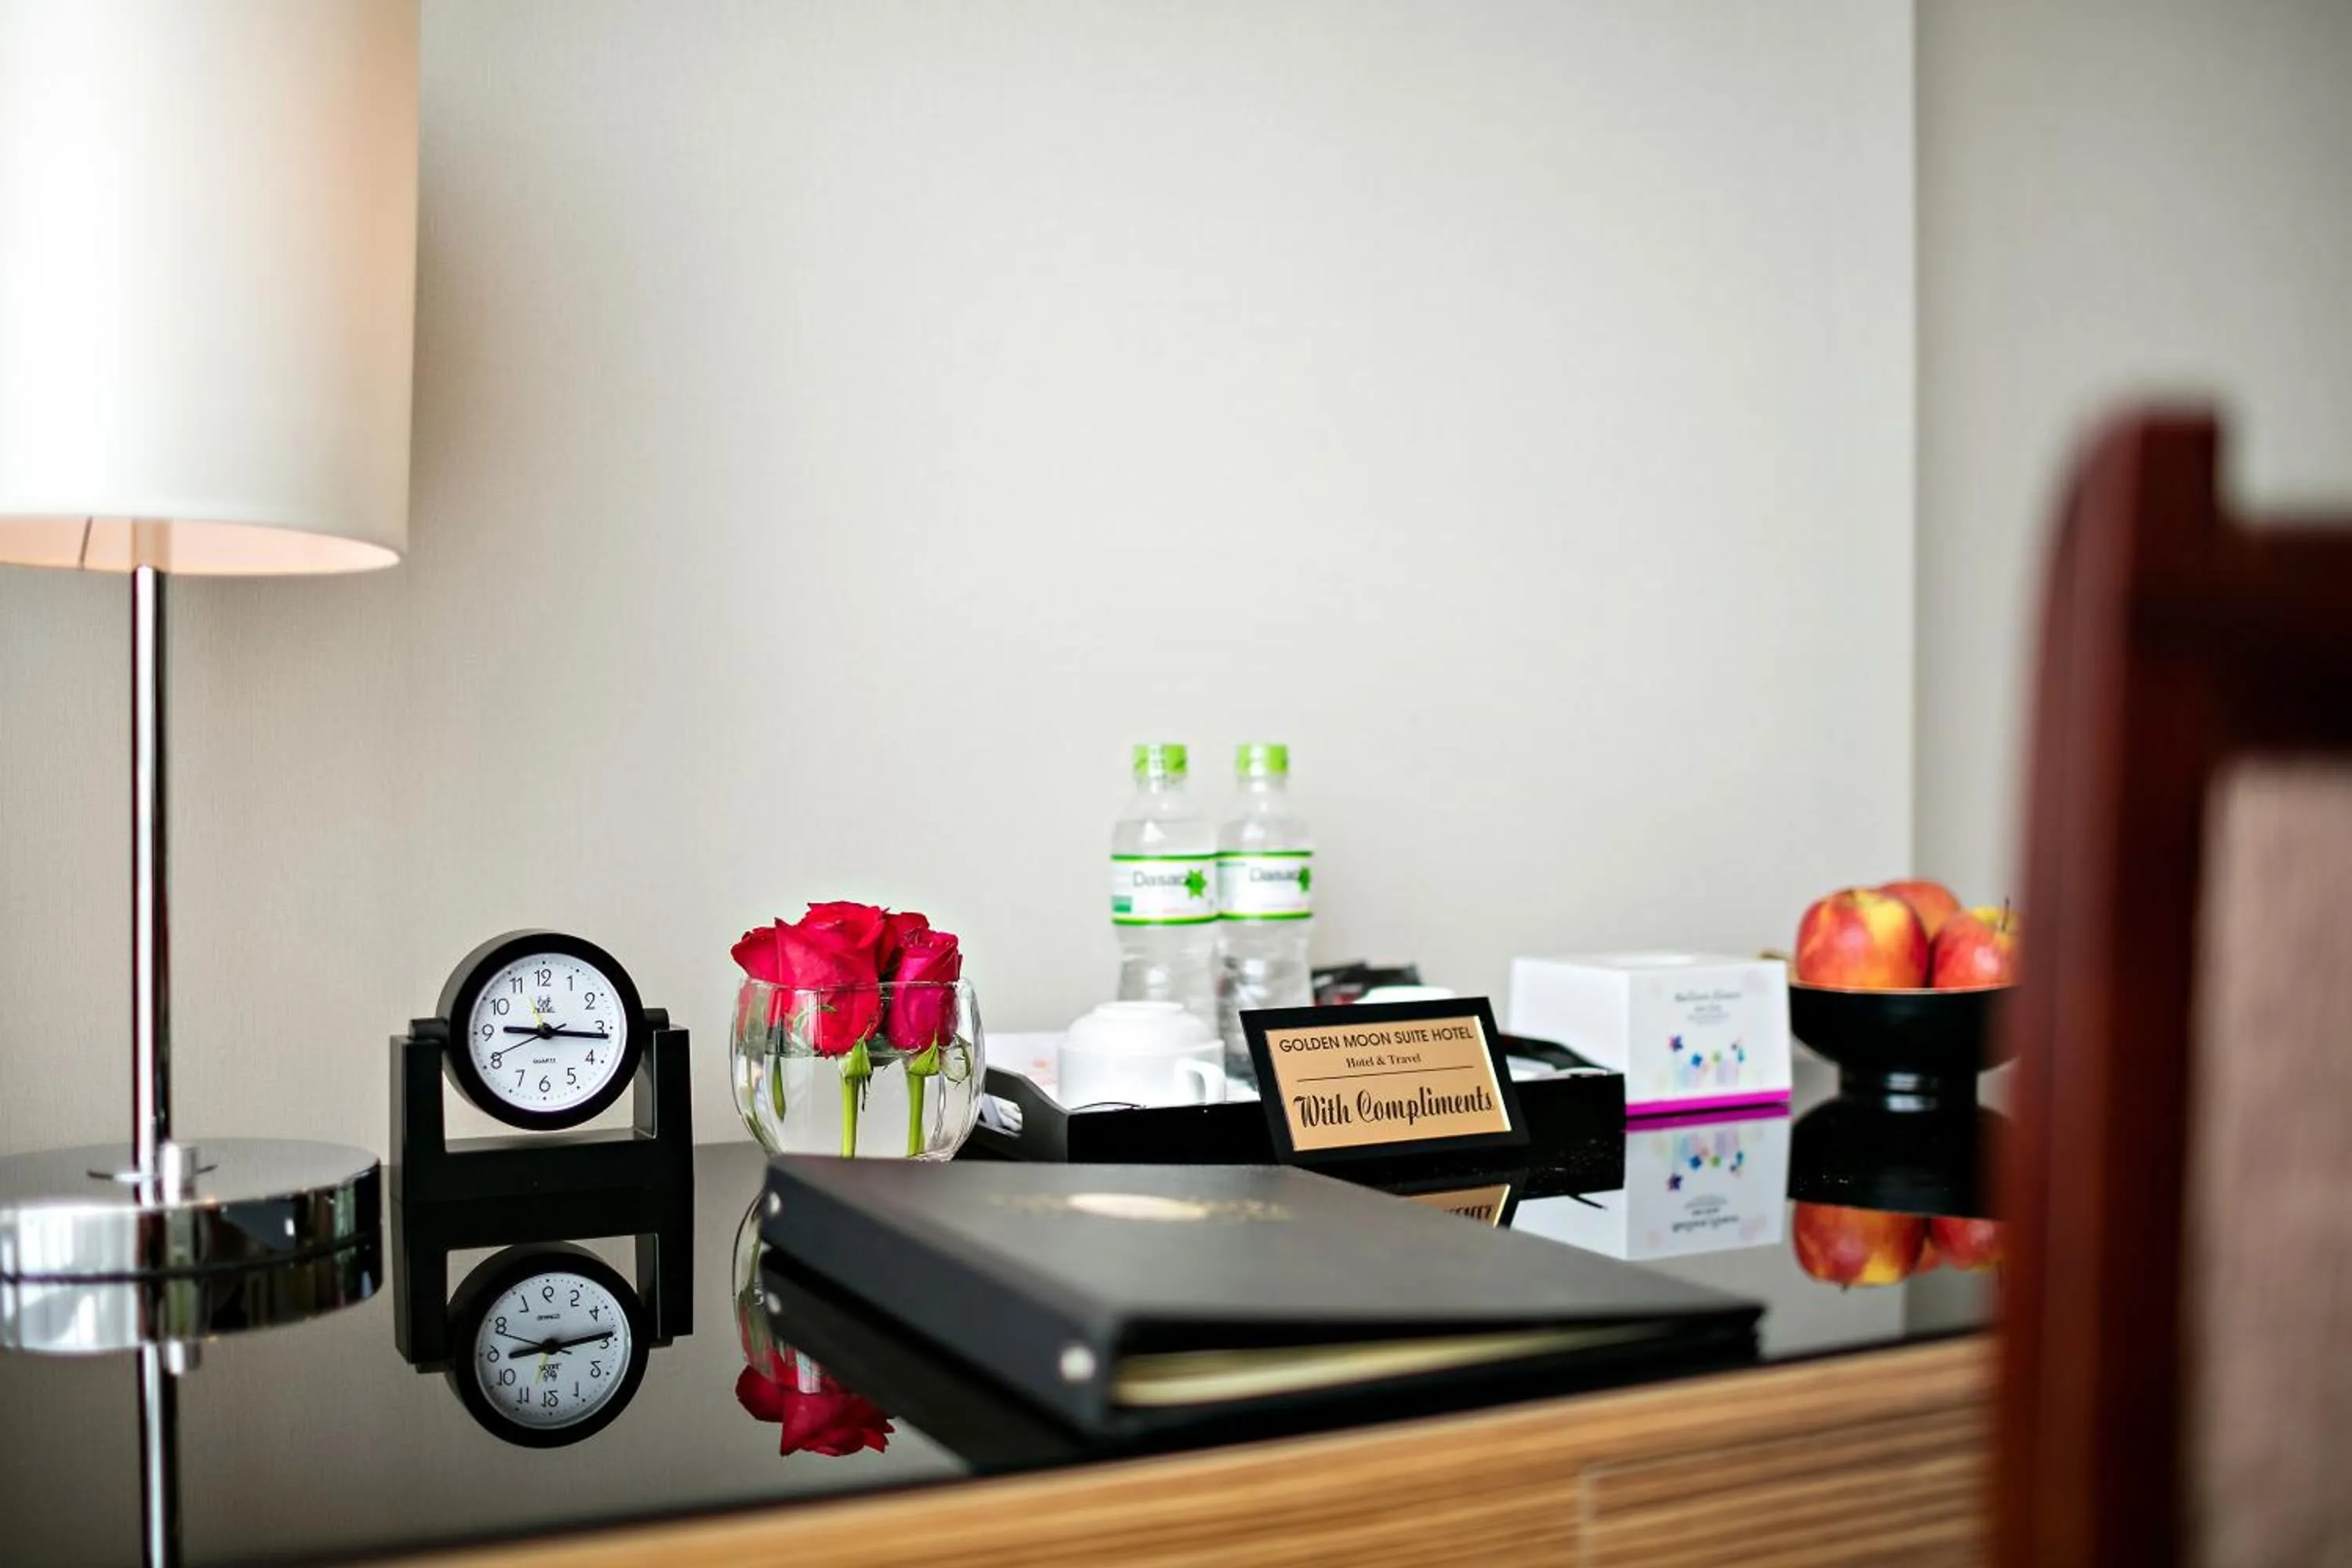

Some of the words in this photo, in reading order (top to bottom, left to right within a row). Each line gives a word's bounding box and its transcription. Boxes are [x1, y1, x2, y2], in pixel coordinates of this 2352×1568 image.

[510, 977, 524, 994] 11
[534, 968, 552, 987] 12
[567, 975, 574, 992] 1
[490, 998, 510, 1015] 10
[584, 992, 596, 1011] 2
[481, 1023, 495, 1042] 9
[594, 1020, 605, 1036] 3
[1279, 1035, 1340, 1052] GOLDEN
[1344, 1031, 1392, 1047] MOON
[1394, 1029, 1430, 1045] SUITE
[1432, 1026, 1473, 1041] HOTEL
[490, 1051, 503, 1069] 8
[585, 1049, 596, 1065] 4
[1345, 1056, 1374, 1069] Hotel
[1377, 1056, 1386, 1065] &
[1387, 1053, 1421, 1065] Travel
[515, 1069, 525, 1087] 7
[539, 1075, 551, 1093] 6
[566, 1067, 577, 1085] 5
[1294, 1093, 1352, 1128] With
[1357, 1085, 1494, 1126] Compliments
